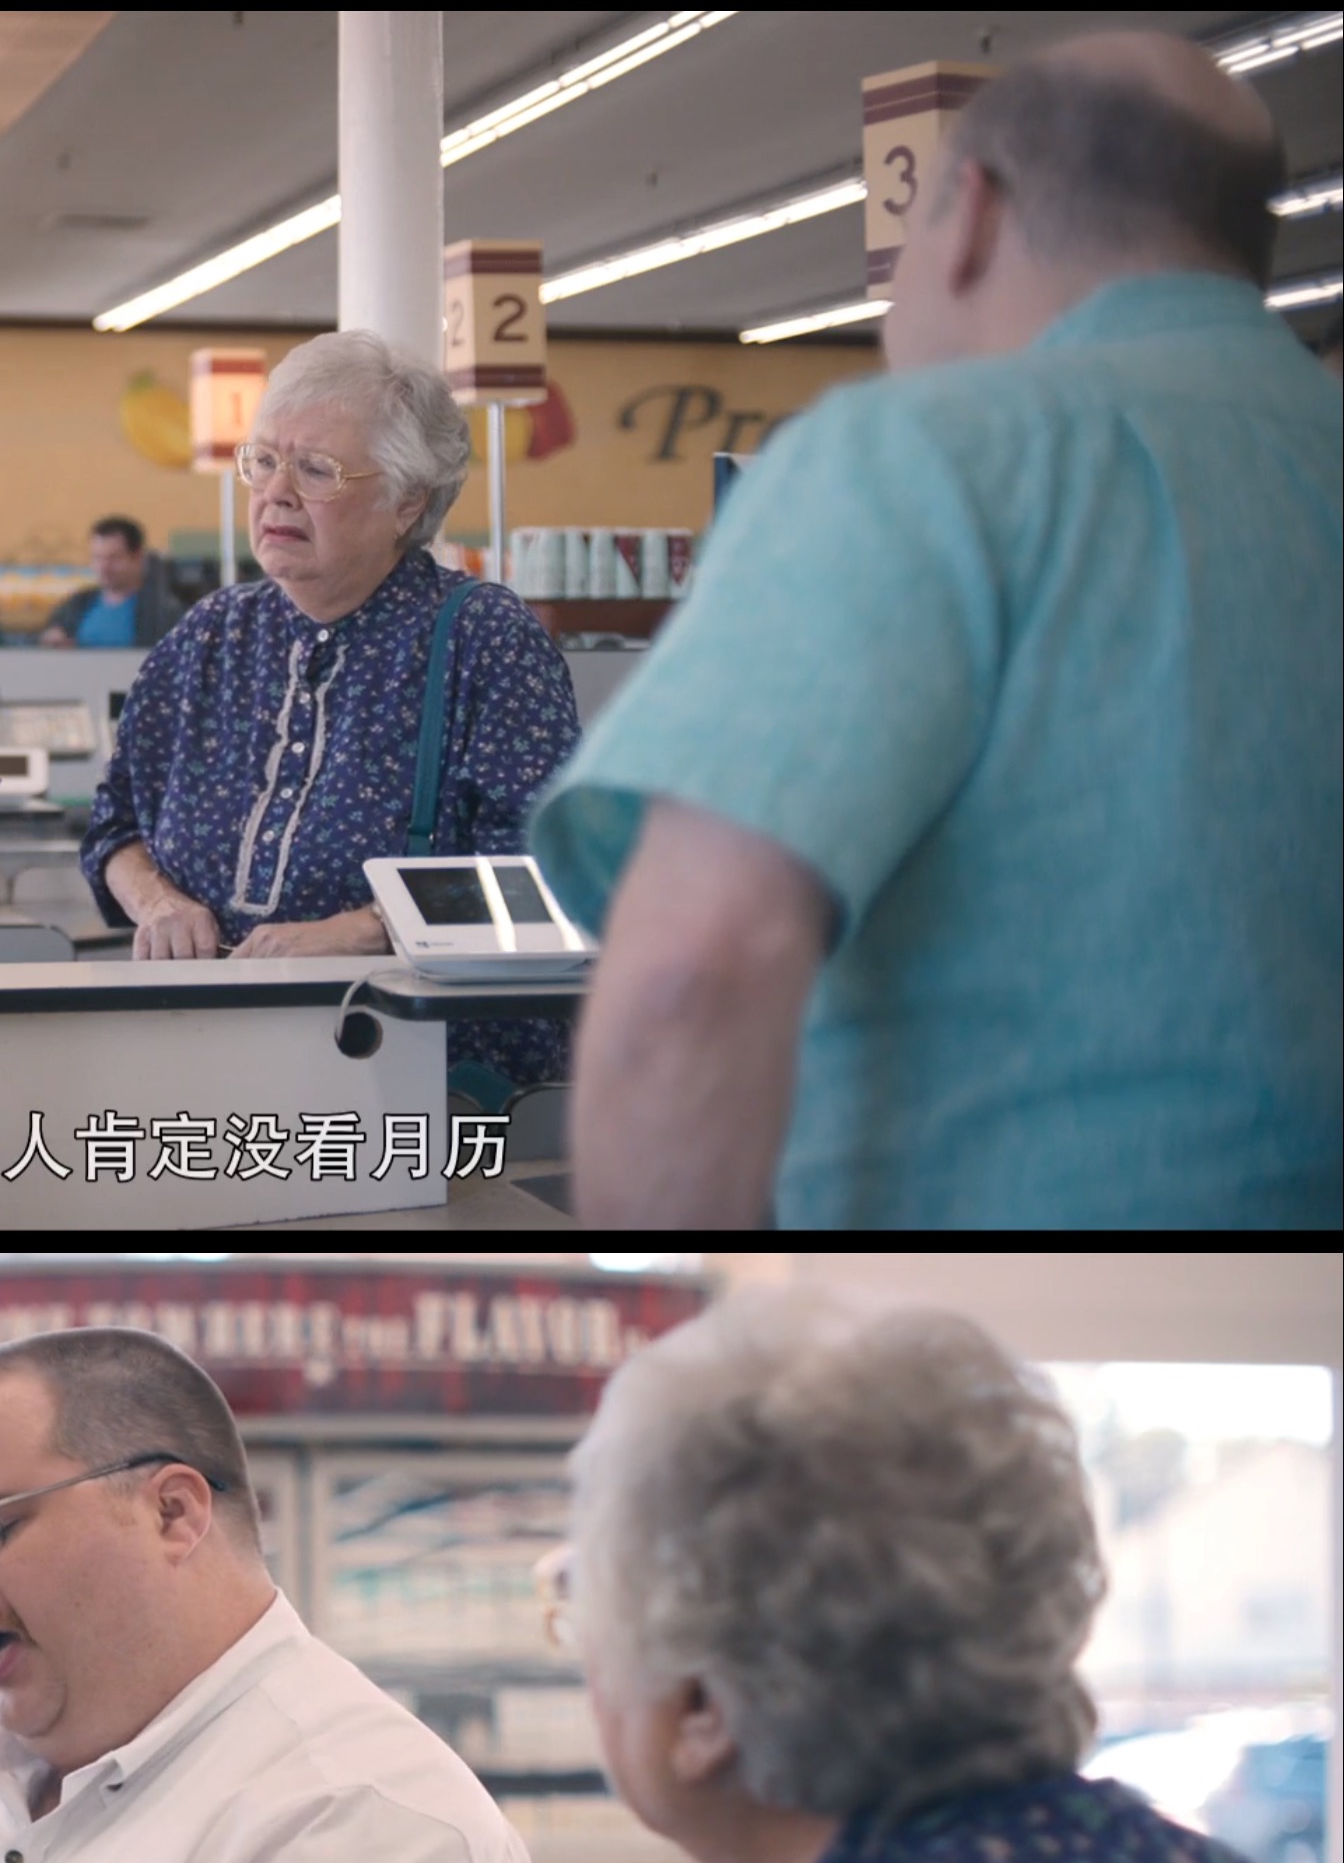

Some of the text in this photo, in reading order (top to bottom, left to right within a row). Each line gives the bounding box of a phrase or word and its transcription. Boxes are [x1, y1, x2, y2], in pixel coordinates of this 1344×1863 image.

[883, 144, 918, 216] 3
[492, 293, 529, 343] 2
[617, 382, 778, 463] Pr
